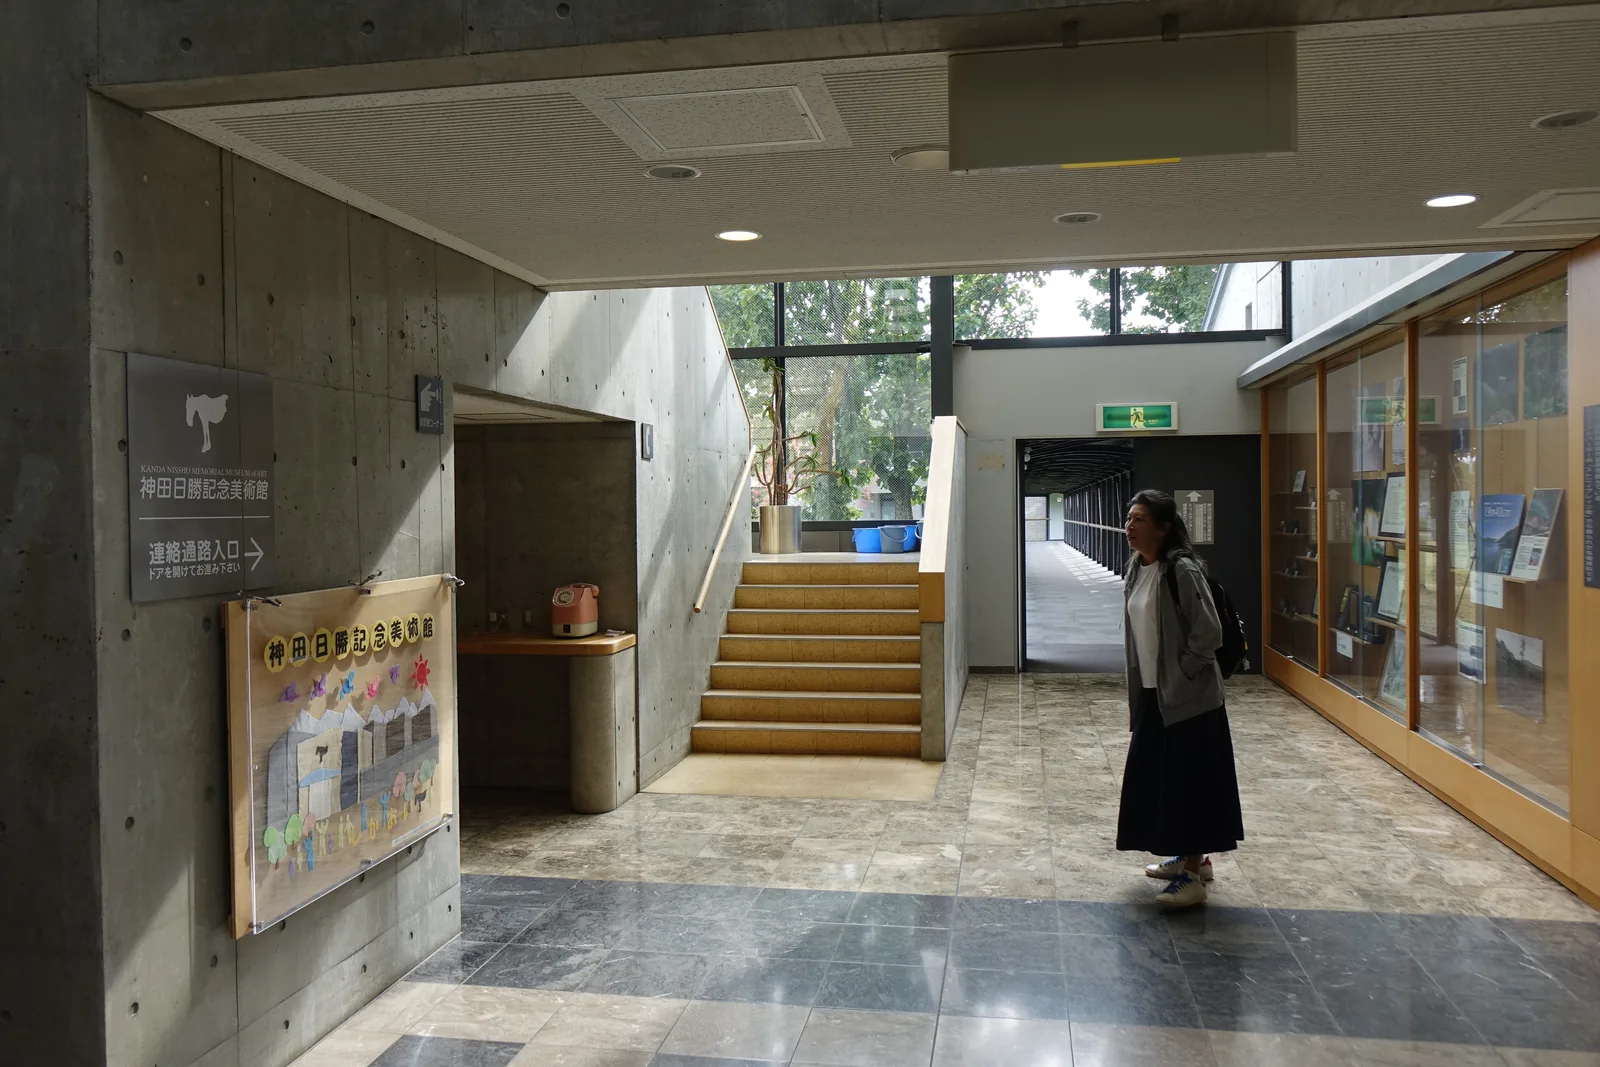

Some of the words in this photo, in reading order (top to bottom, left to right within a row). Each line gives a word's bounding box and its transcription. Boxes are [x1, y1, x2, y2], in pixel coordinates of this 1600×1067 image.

[140, 464, 166, 473] KANDA
[166, 466, 191, 474] NISSHO
[192, 467, 225, 475] MEMORIAL
[226, 469, 251, 477] MUSEUM
[257, 470, 268, 478] ART
[140, 476, 268, 500] 神田日勝記念美術館
[149, 540, 239, 564] 連絡通路入口
[149, 563, 240, 580] ドアを開けてお進み下さい
[268, 615, 434, 668] 神田日勝記念美術館
